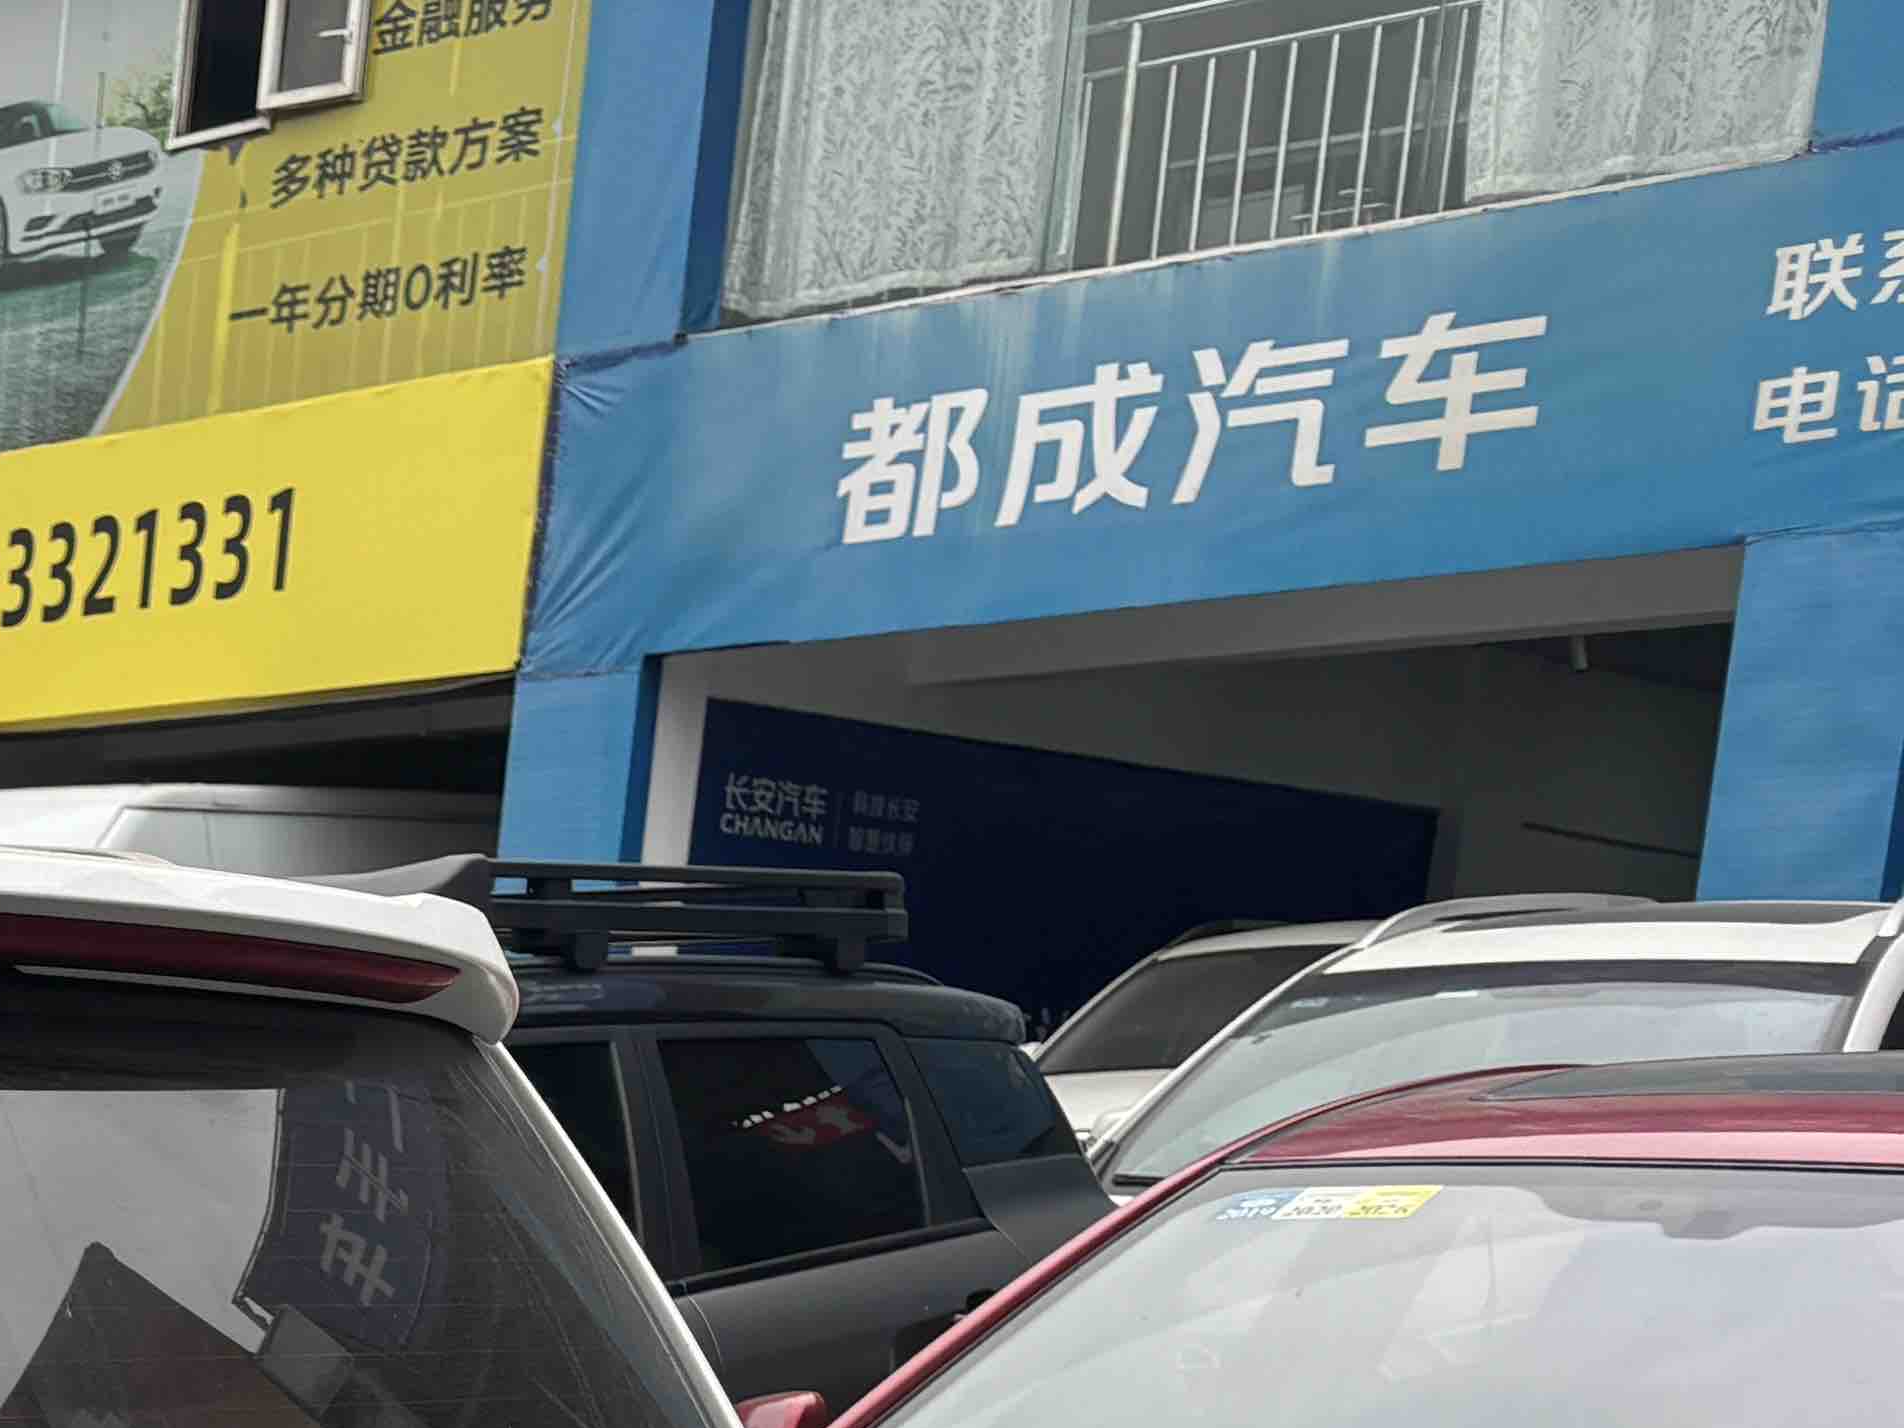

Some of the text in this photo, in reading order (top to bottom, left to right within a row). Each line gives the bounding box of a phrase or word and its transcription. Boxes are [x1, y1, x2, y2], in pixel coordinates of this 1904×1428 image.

[270, 106, 544, 209] 多种贷款方案
[836, 310, 1549, 545] 都成汽车
[719, 812, 825, 846] CHANGAN
